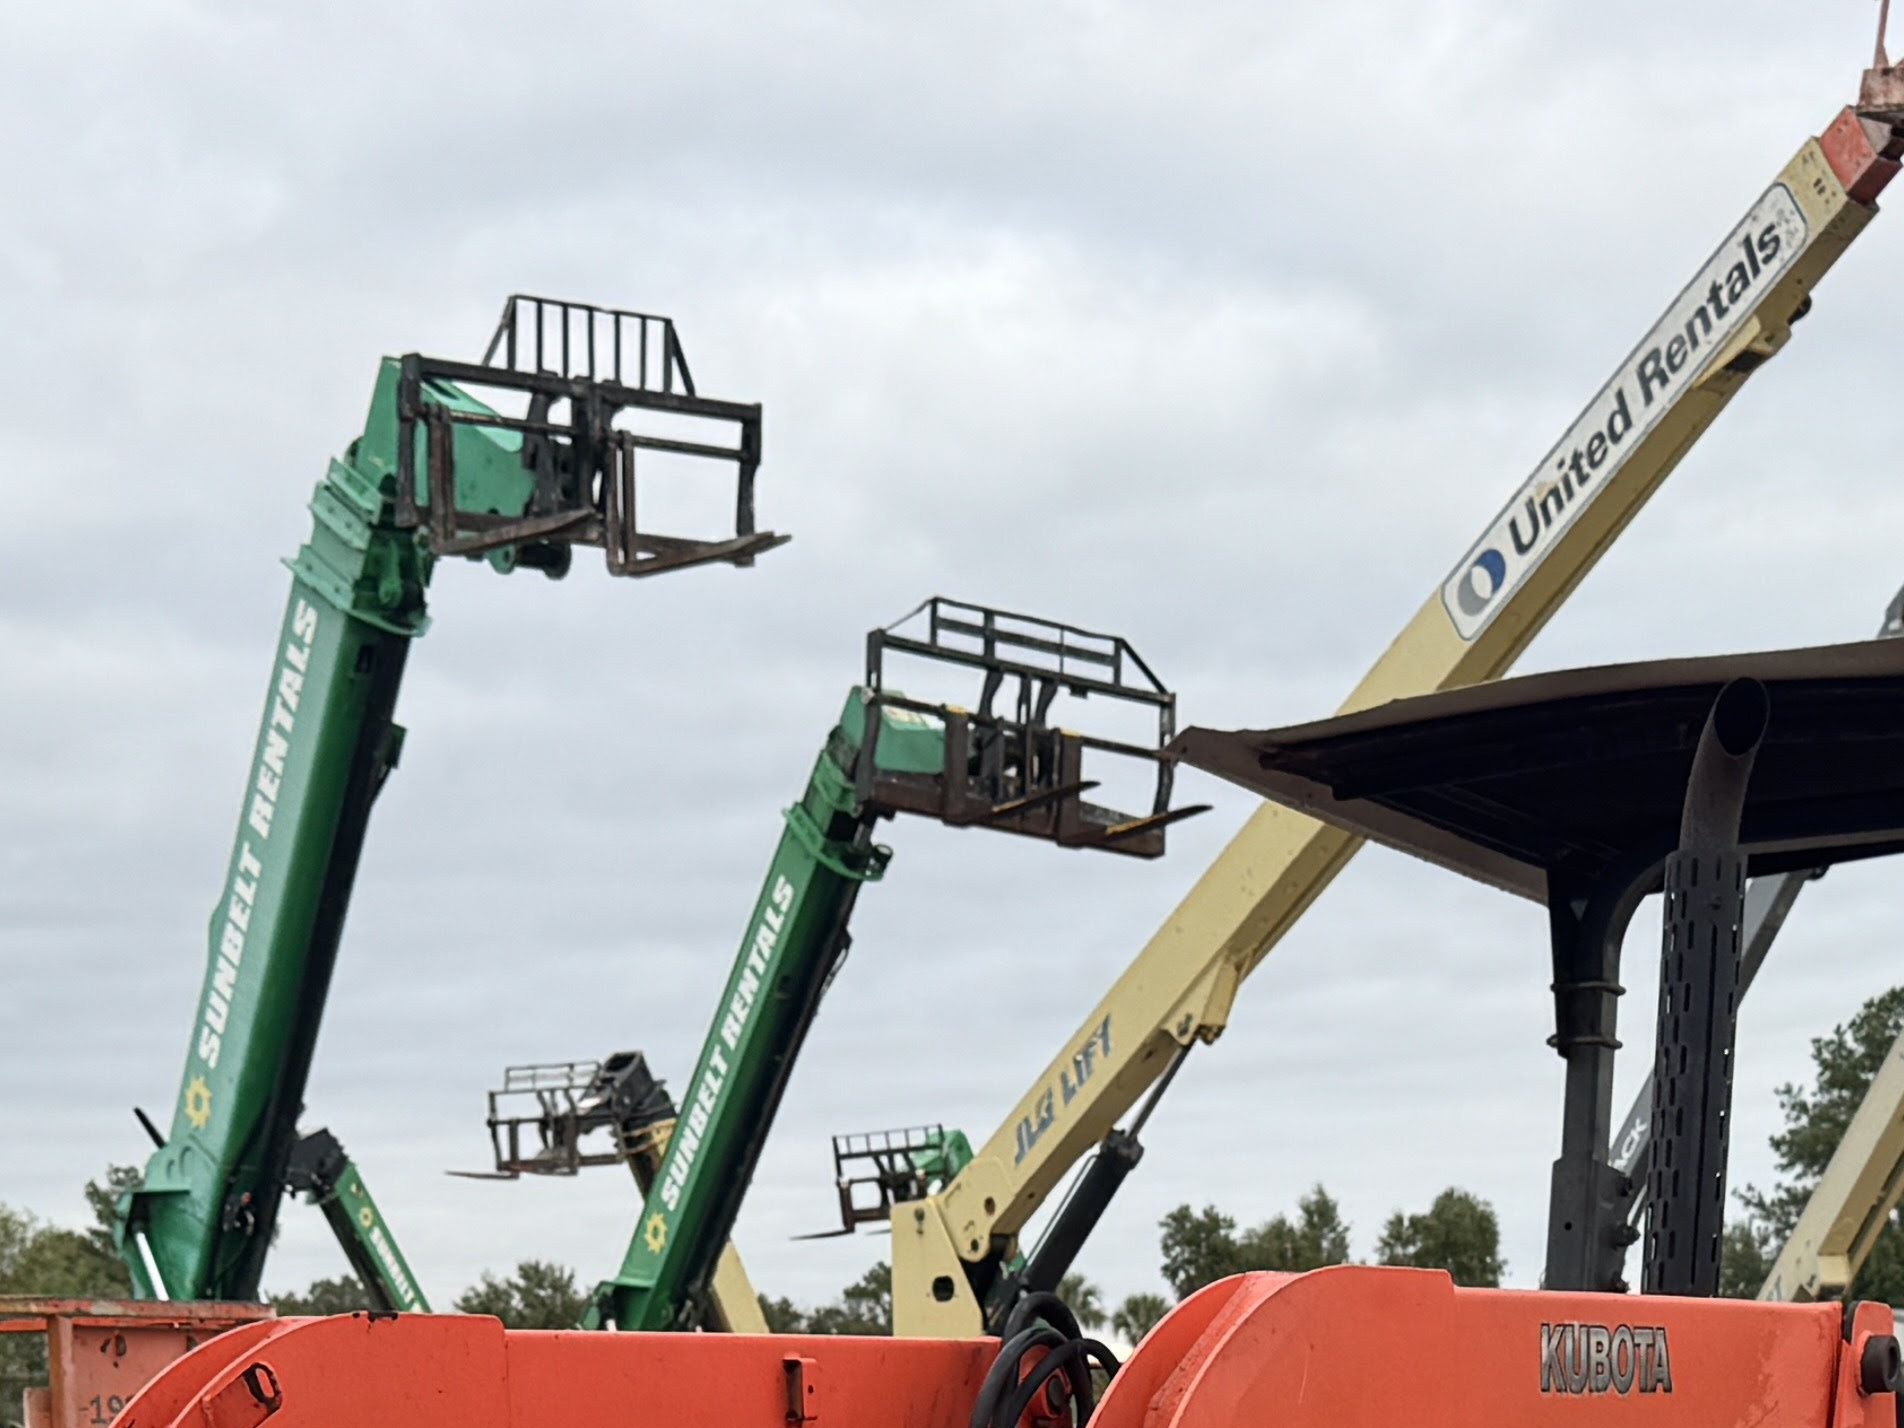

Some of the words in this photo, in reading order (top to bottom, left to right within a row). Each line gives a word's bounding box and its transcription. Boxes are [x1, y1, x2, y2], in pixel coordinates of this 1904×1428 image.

[1508, 388, 1634, 557] United
[1636, 222, 1781, 406] Rentals
[198, 841, 262, 1070] SUNBELT
[248, 599, 318, 840] RENTALS
[660, 1044, 729, 1212] SUNBELT
[720, 874, 794, 1051] RENTALS
[1540, 1322, 1673, 1394] KUBOTA
